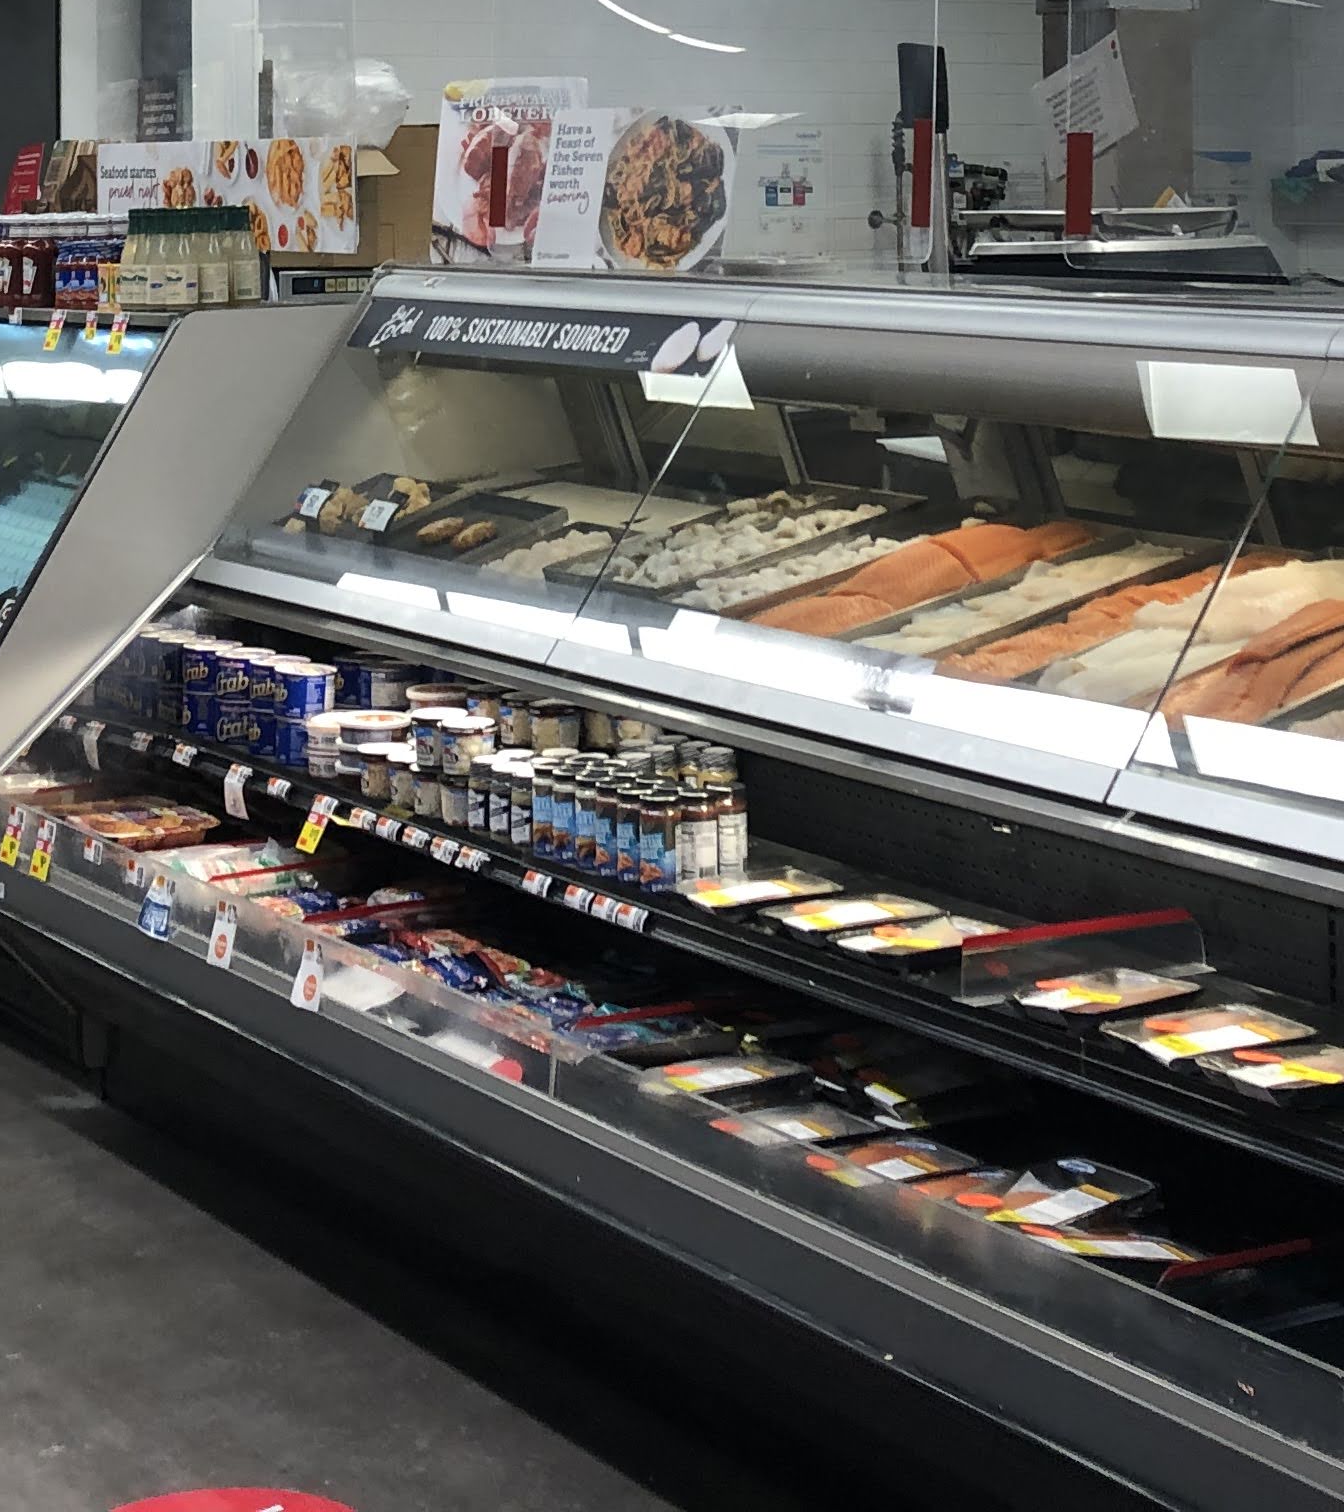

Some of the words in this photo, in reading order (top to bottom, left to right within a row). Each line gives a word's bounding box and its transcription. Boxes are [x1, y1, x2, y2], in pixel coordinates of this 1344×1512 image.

[557, 123, 584, 135] Have
[586, 125, 593, 135] a
[555, 138, 582, 149] Feast
[583, 136, 596, 148] of
[553, 152, 571, 163] the
[571, 151, 604, 163] Seven
[100, 165, 129, 179] Seafood
[129, 167, 157, 179] starters
[551, 164, 584, 176] Fishes
[549, 180, 580, 190] worth
[546, 190, 590, 215] savoring
[423, 314, 467, 342] 100%
[461, 317, 556, 349] SUSTAINABLY
[552, 323, 631, 355] SOURCED
[184, 661, 209, 682] rab
[216, 670, 250, 696] Crab
